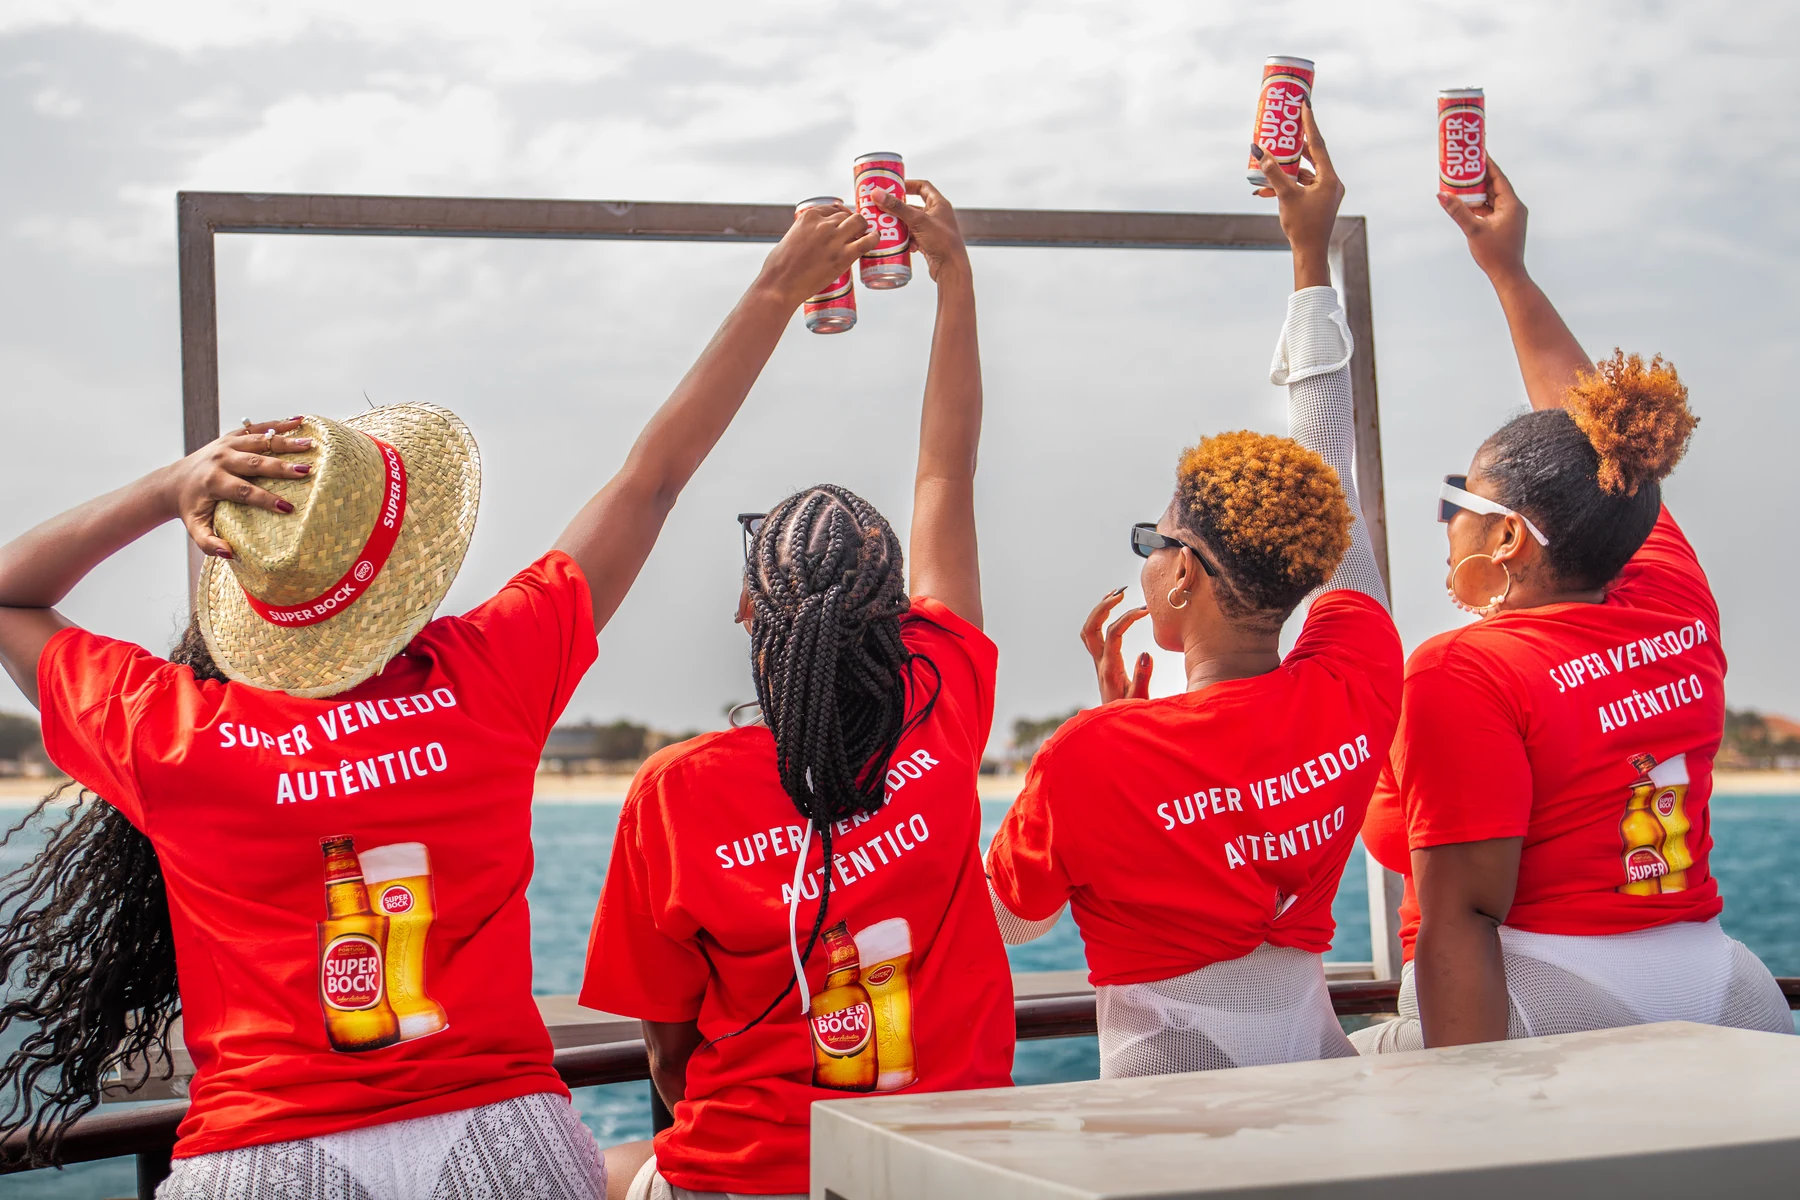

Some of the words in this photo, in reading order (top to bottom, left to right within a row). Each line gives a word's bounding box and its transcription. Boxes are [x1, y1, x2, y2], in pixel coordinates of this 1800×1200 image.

[1259, 87, 1286, 151] SUPER
[1278, 92, 1304, 150] BOCK
[1446, 118, 1465, 177] SUPER
[1464, 120, 1482, 173] BOCK
[859, 182, 878, 235] UPER
[878, 184, 899, 241] BOK
[383, 482, 401, 529] SUPER
[268, 609, 316, 622] SUPER
[313, 583, 356, 615] BOCK
[1549, 652, 1611, 693] SUPER
[218, 722, 313, 756] SUPER
[317, 687, 457, 741] VENCEDO
[1598, 673, 1704, 734] AUTÊNTICO
[276, 742, 448, 804] AUTÊNTICO
[1157, 787, 1244, 831] SUPER
[1249, 734, 1371, 810] VENCEDOR
[715, 825, 805, 869] SUPER
[1630, 863, 1665, 880] SUPER
[384, 894, 409, 904] SUPER
[386, 900, 409, 910] BOCK
[326, 956, 378, 977] SUPER
[327, 973, 377, 994] BOCK
[817, 1014, 867, 1034] BOCK
